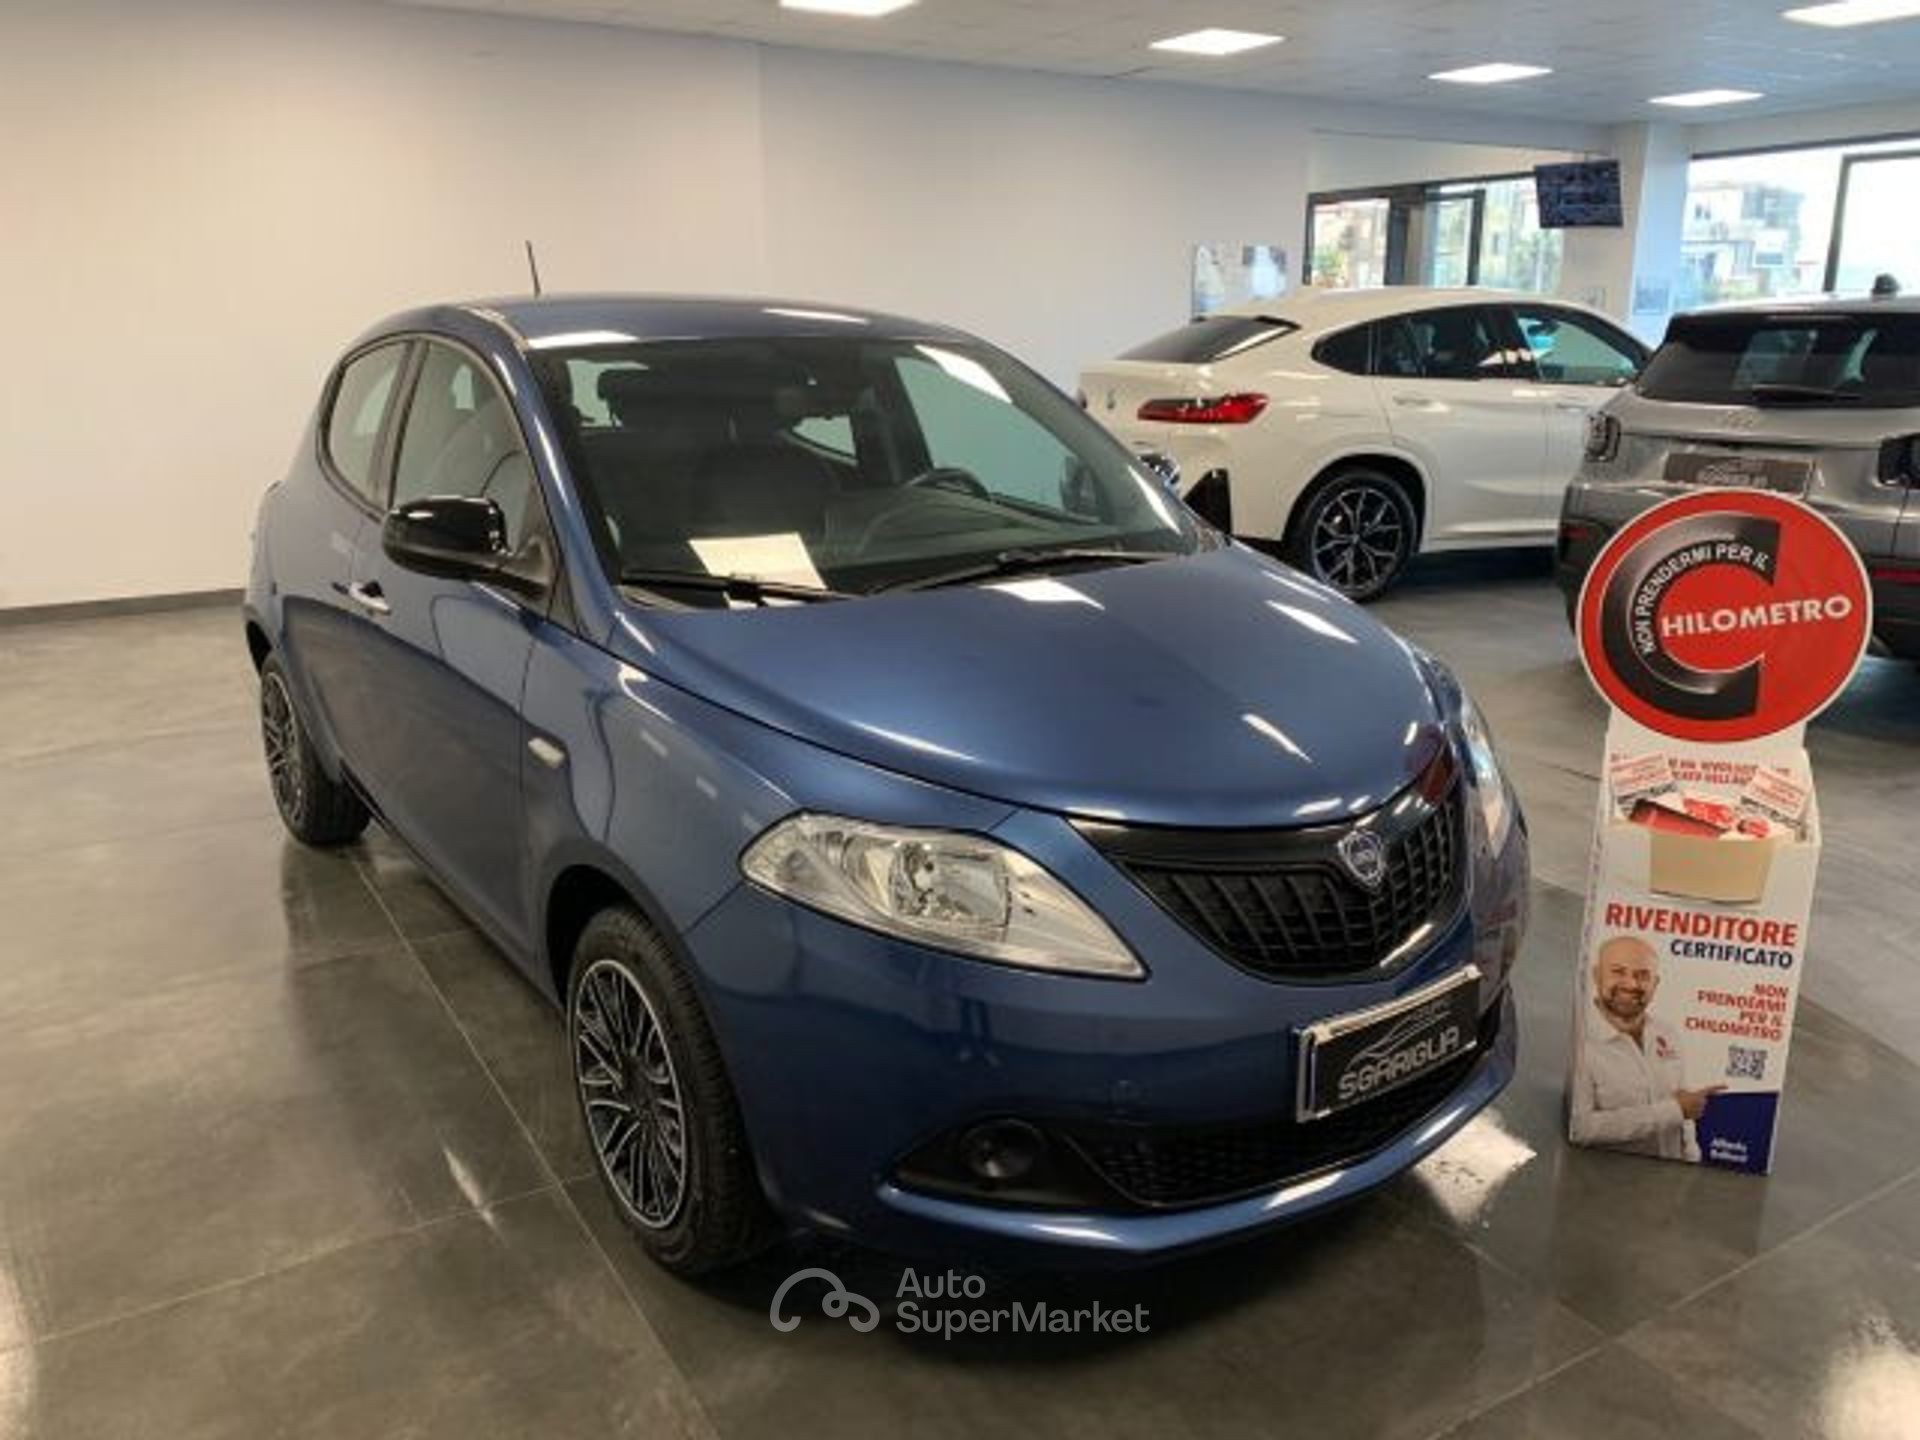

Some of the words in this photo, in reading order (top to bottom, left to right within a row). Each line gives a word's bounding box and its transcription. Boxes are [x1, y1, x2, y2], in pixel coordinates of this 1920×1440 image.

[1715, 543, 1752, 564] PER
[1753, 551, 1769, 572] IL
[1635, 543, 1711, 616] PRENDERMI
[1635, 621, 1657, 654] NON
[1605, 902, 1799, 947] RIVENDITORE
[1670, 938, 1794, 970] CERTIFICATO
[1697, 990, 1787, 1012] PRENDERMI
[1754, 983, 1789, 998] NON
[1685, 1016, 1782, 1041] CHILOMETRO
